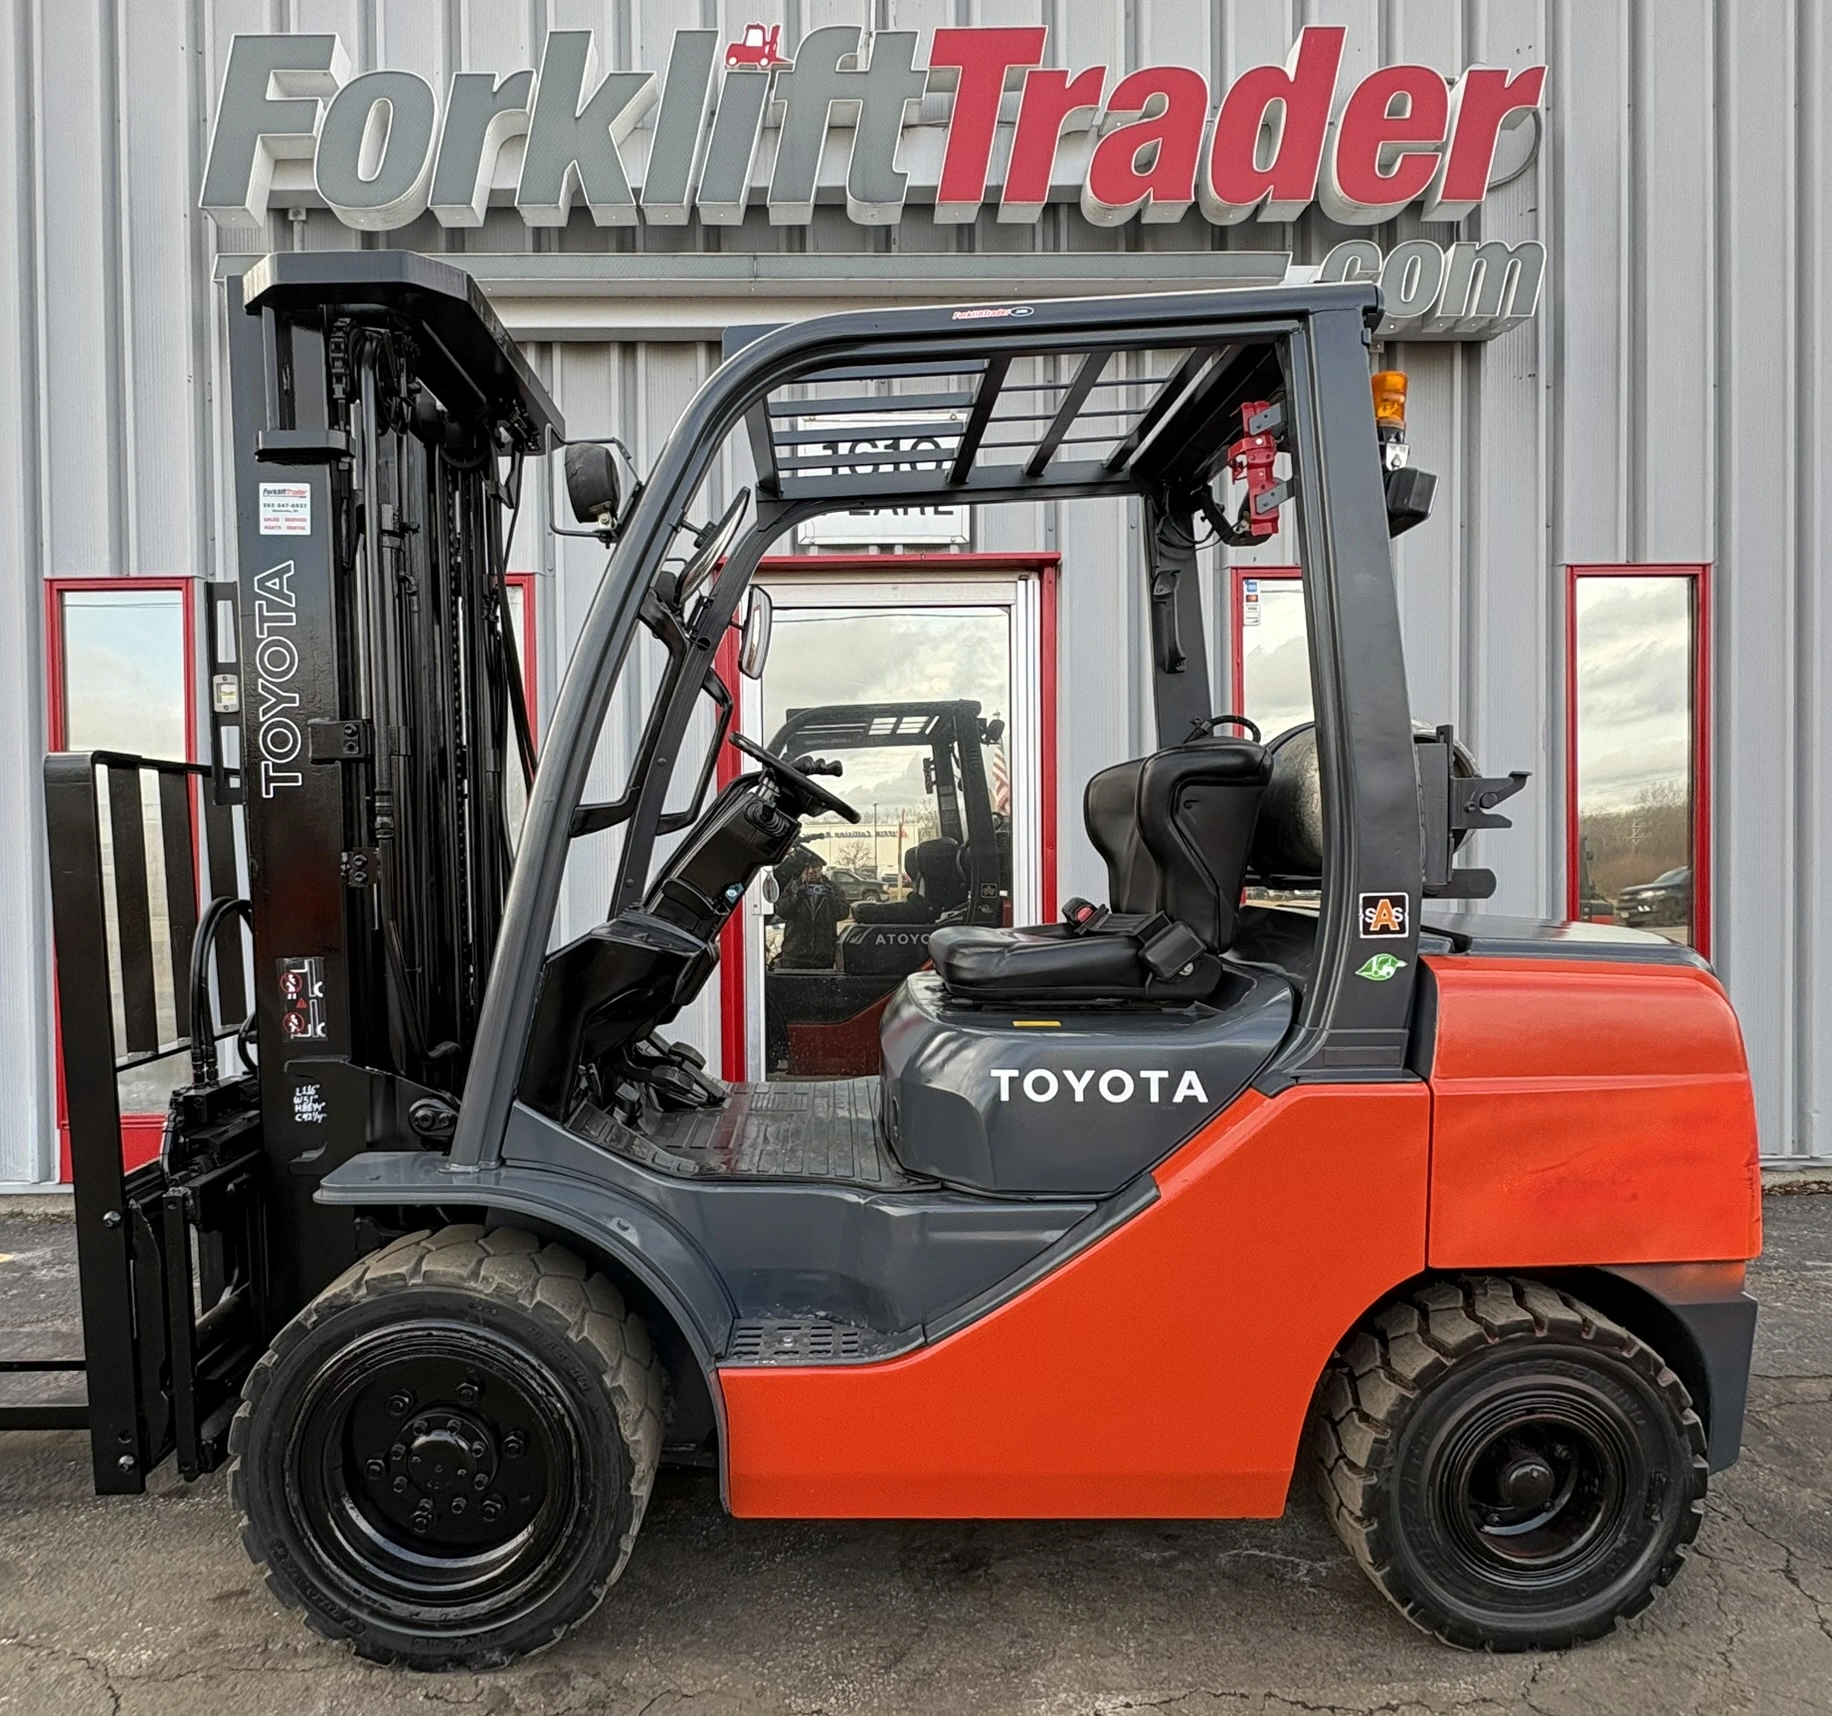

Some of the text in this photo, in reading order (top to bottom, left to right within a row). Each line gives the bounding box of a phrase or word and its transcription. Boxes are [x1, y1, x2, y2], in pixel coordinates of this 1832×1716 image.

[198, 25, 1548, 220] ForkliftTrader
[254, 560, 303, 799] TOYOTA
[990, 1068, 1209, 1104] TOYOTA
